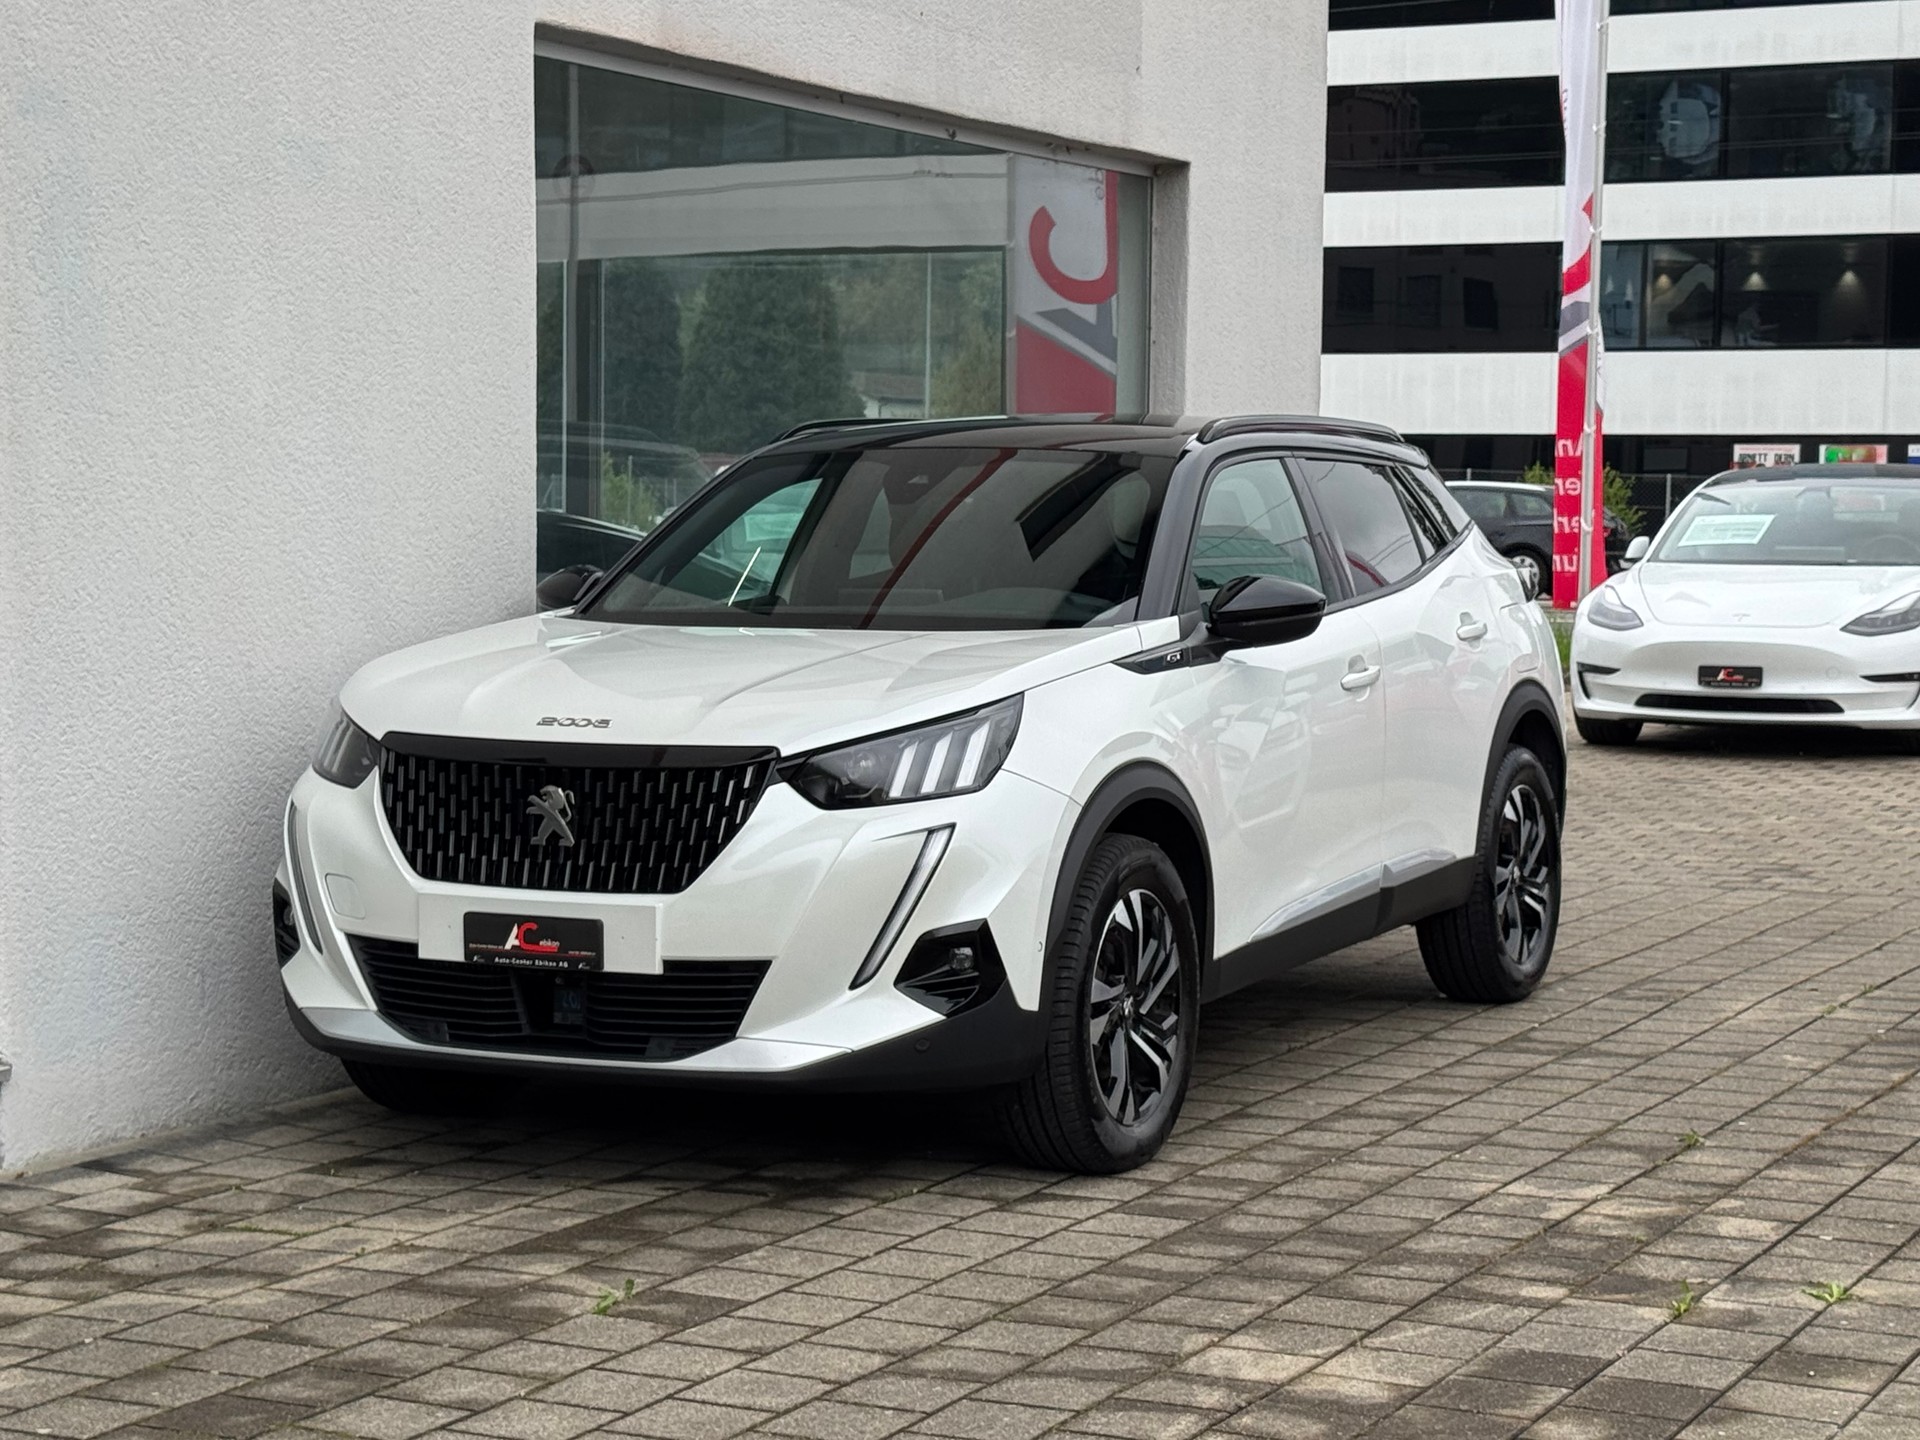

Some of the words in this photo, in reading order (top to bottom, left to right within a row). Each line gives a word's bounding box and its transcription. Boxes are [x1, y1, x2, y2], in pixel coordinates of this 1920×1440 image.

[504, 922, 558, 951] AC
[494, 956, 533, 965] Auto-Center
[535, 959, 556, 967] Ebikon
[558, 960, 568, 968] AG
